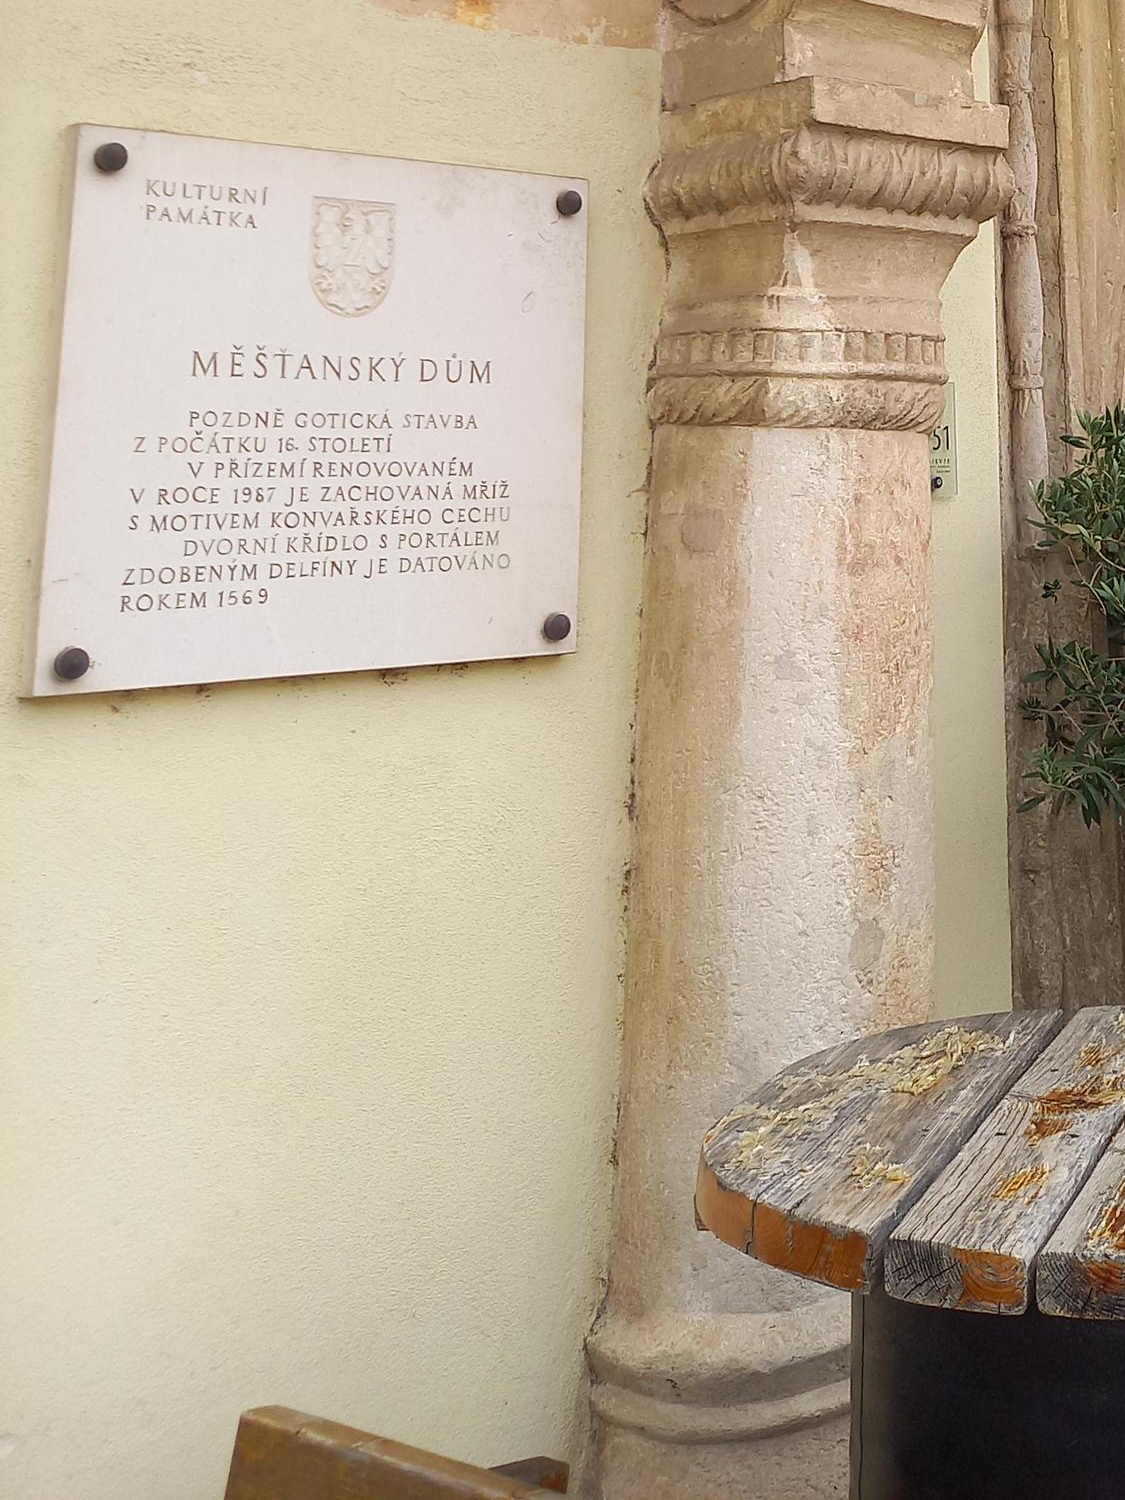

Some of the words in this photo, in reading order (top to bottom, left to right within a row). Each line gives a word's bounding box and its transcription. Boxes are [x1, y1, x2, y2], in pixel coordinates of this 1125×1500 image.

[145, 179, 269, 206] KULTURNÍ
[145, 203, 258, 229] PAMÁTKA
[191, 344, 406, 383] MĚŠŤANSKÝ
[420, 352, 492, 384] DŮM
[189, 408, 285, 428] POZDNĚ
[295, 409, 393, 429] GOTICKÁ
[402, 413, 478, 430] STAVBA
[133, 437, 147, 453] Z
[158, 430, 267, 454] POČÁTKU
[278, 437, 299, 453] 16.
[308, 433, 393, 453] STOLETÍ
[187, 462, 205, 479] V
[214, 458, 307, 479] PŘÍZEMÍ
[312, 457, 474, 478] RENOVOVANÉM
[129, 488, 145, 504] V
[156, 486, 221, 505] ROCE
[233, 486, 276, 504] 1987
[285, 486, 310, 507] JE
[320, 481, 454, 502] ZACHOVANÁ
[462, 480, 510, 500] MŘÍŽ
[128, 515, 139, 530] S
[150, 512, 260, 533] MOTIVEM
[271, 505, 432, 529] KONVAŘSKÉHO
[441, 506, 511, 524] CECHU
[184, 532, 280, 556] DVORNÍ
[286, 531, 368, 554] KŘÍDLO
[379, 534, 388, 549] S
[398, 527, 500, 549] PORTÁLEM
[122, 558, 258, 586] ZDOBENÝM
[269, 556, 357, 580] DELFÍNY
[363, 558, 388, 579] JE
[399, 551, 511, 573] DATOVÁNO
[120, 591, 207, 612] ROKEM
[218, 588, 269, 608] 1569
